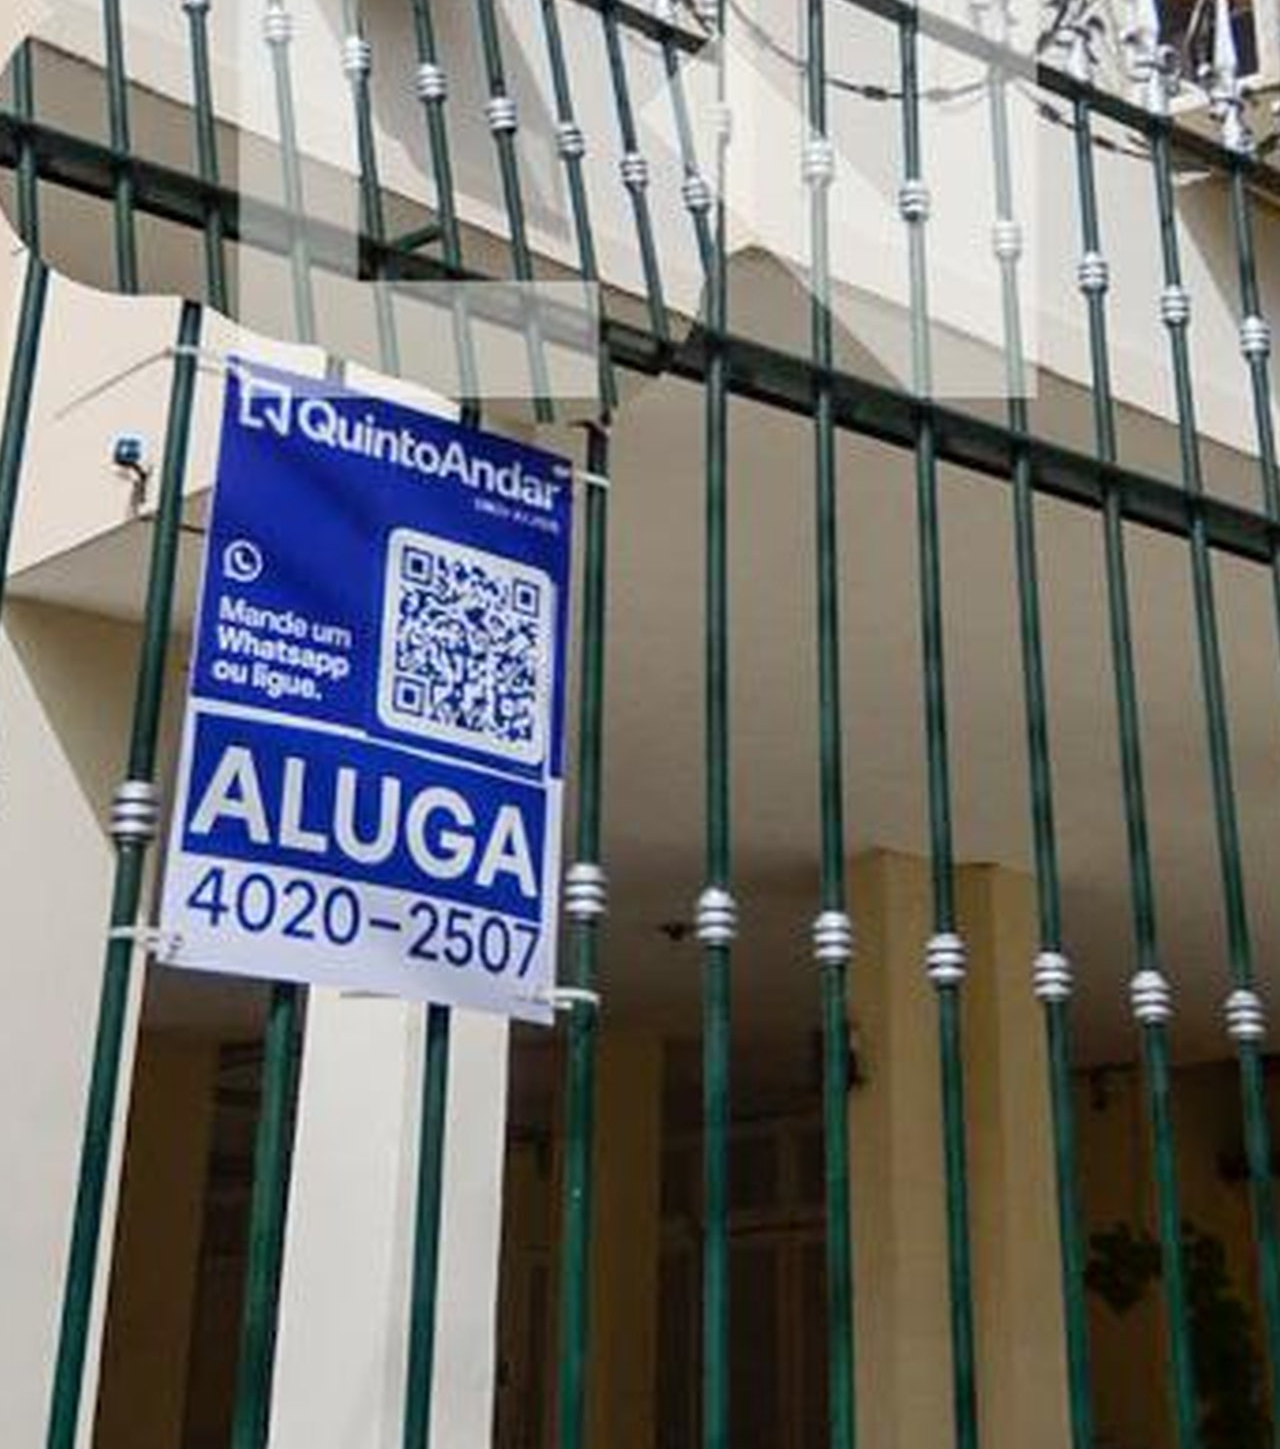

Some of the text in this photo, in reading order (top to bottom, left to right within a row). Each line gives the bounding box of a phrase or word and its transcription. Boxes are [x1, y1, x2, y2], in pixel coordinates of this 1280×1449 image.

[297, 399, 561, 511] QuintoAndar
[212, 660, 322, 700] ou ligue.
[311, 622, 352, 648] um
[188, 745, 538, 898] ALUGA
[187, 868, 541, 978] 4020-2507
